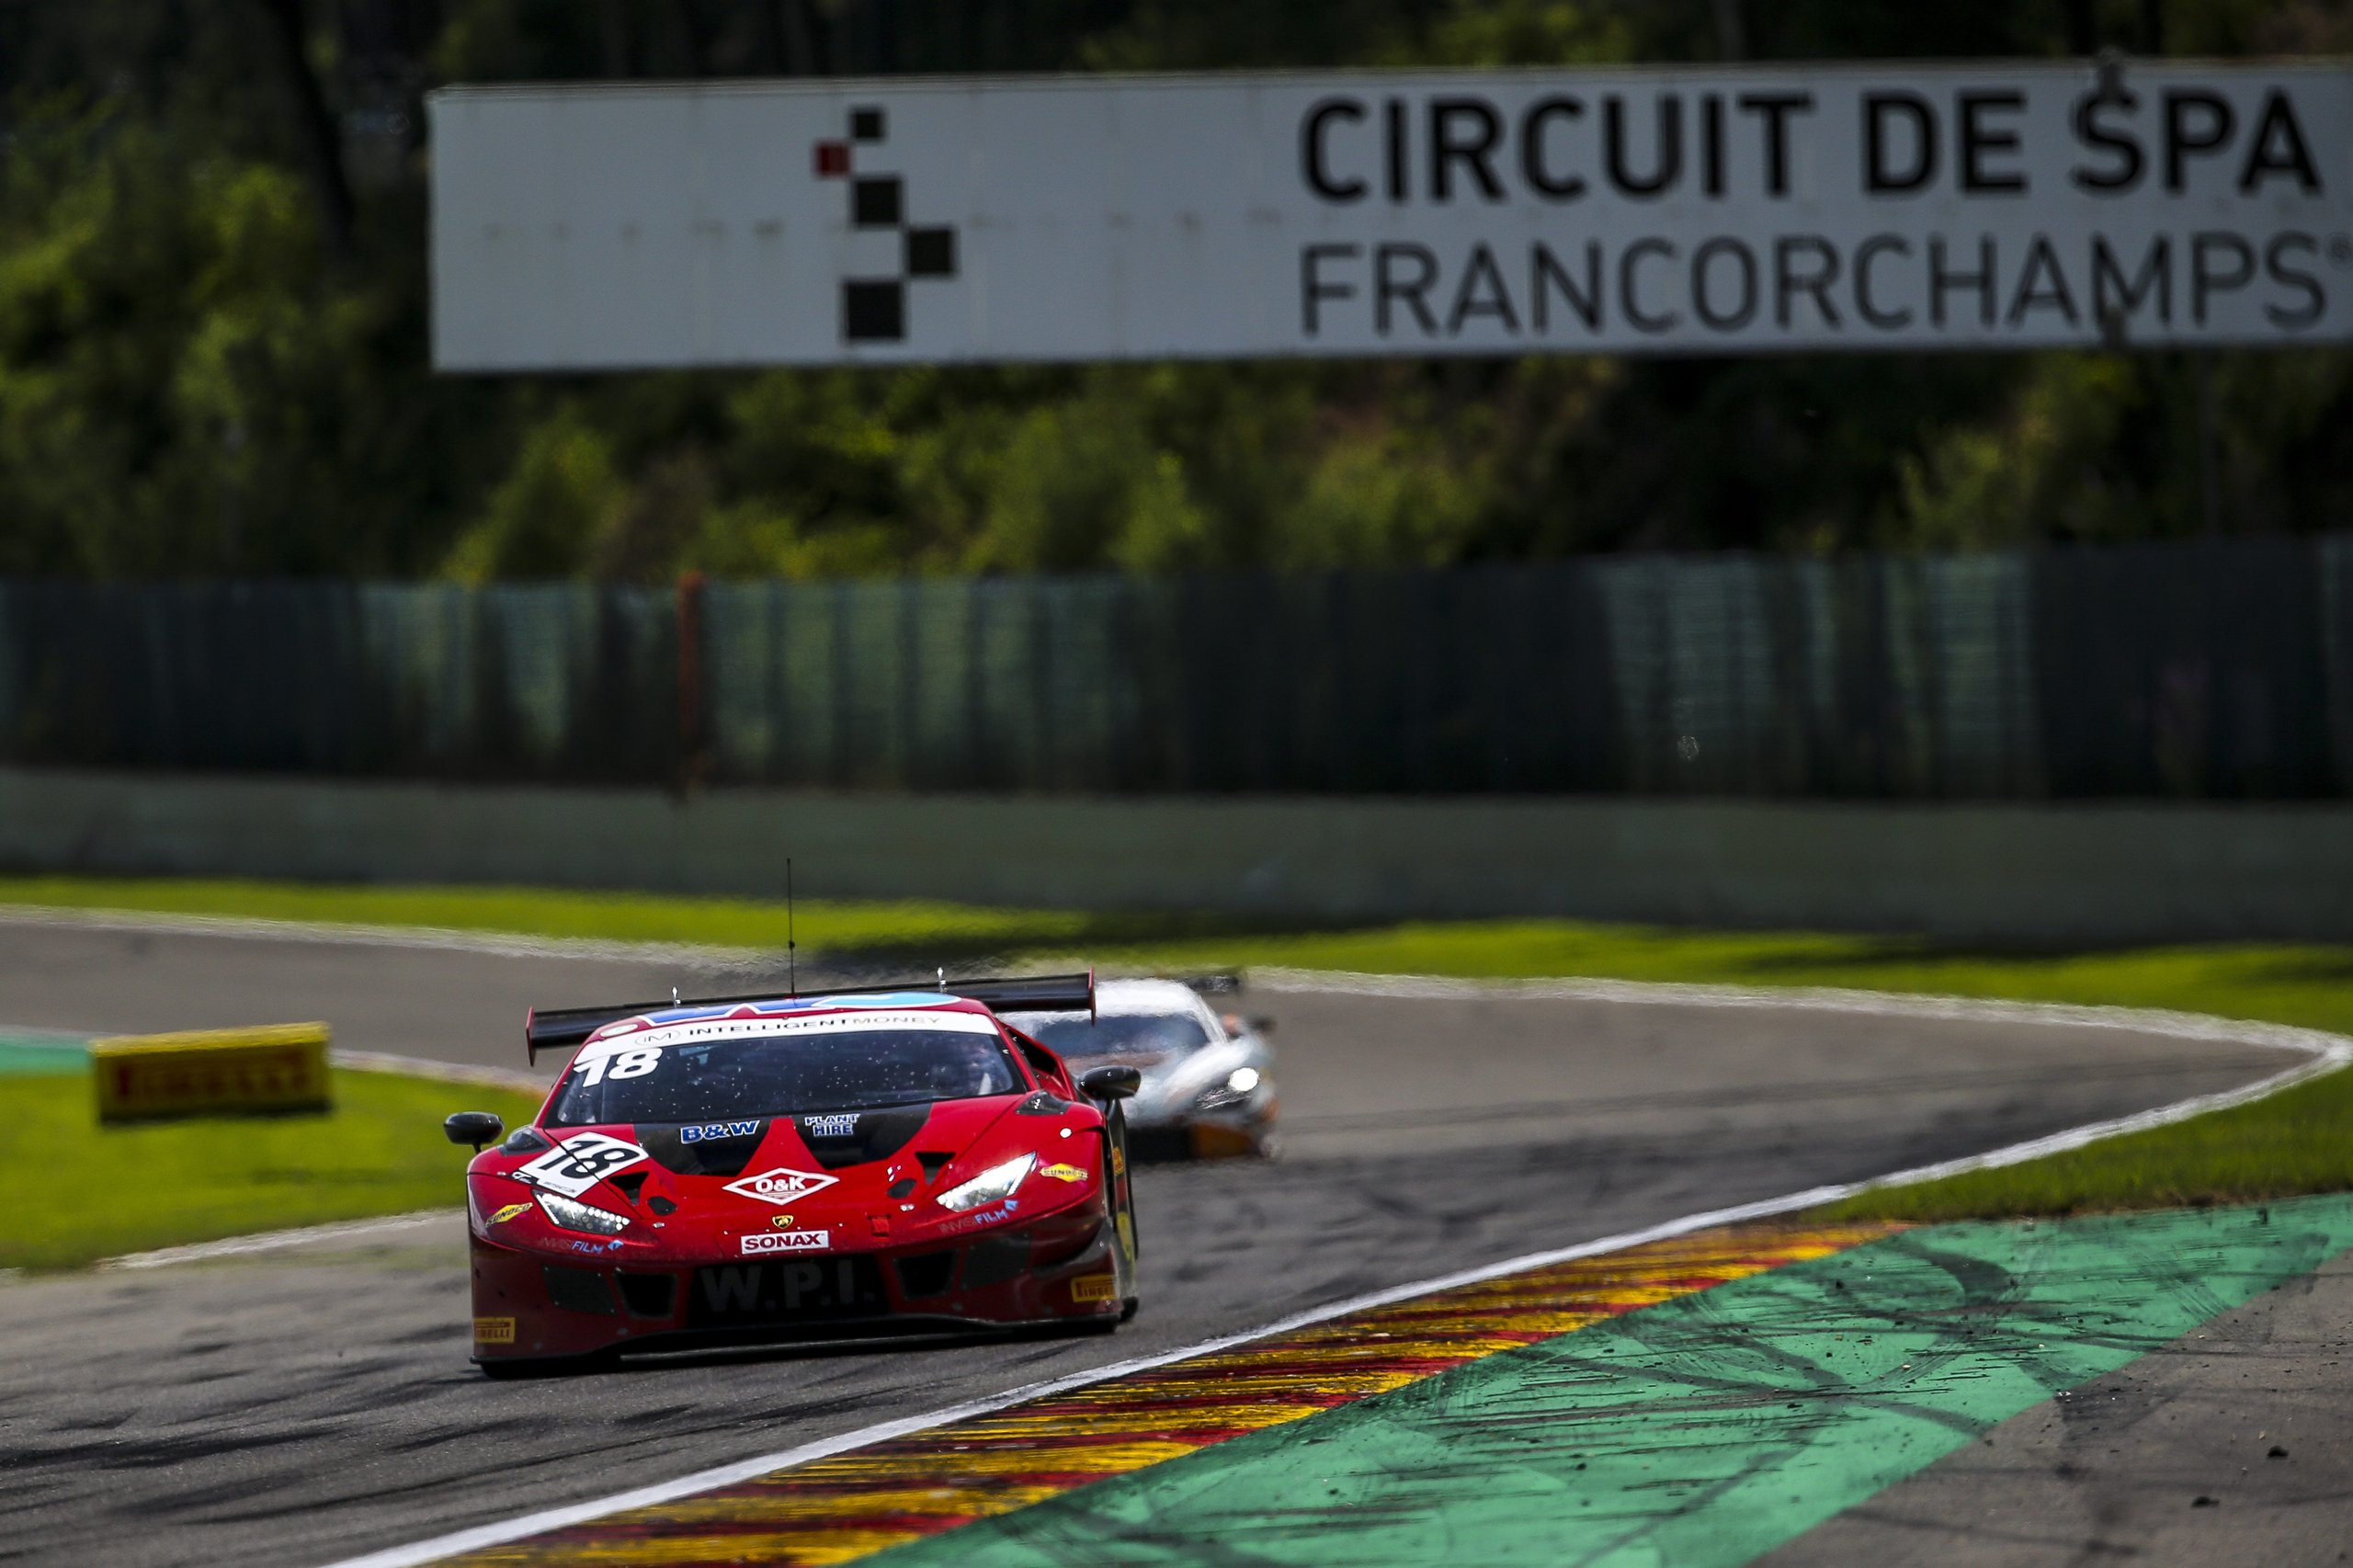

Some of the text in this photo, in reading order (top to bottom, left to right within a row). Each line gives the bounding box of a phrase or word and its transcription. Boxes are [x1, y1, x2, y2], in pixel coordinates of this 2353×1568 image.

[1301, 85, 2325, 206] CIRCUIT DE SPA
[1300, 231, 2327, 338] FRANCORCHAMPS
[573, 1046, 663, 1088] 18
[680, 1119, 761, 1145] B&W
[804, 1113, 861, 1126] PLANT
[813, 1123, 854, 1137] HIRE
[537, 1140, 641, 1179] 18
[755, 1176, 806, 1194] O&K
[744, 1233, 821, 1251] SONAX
